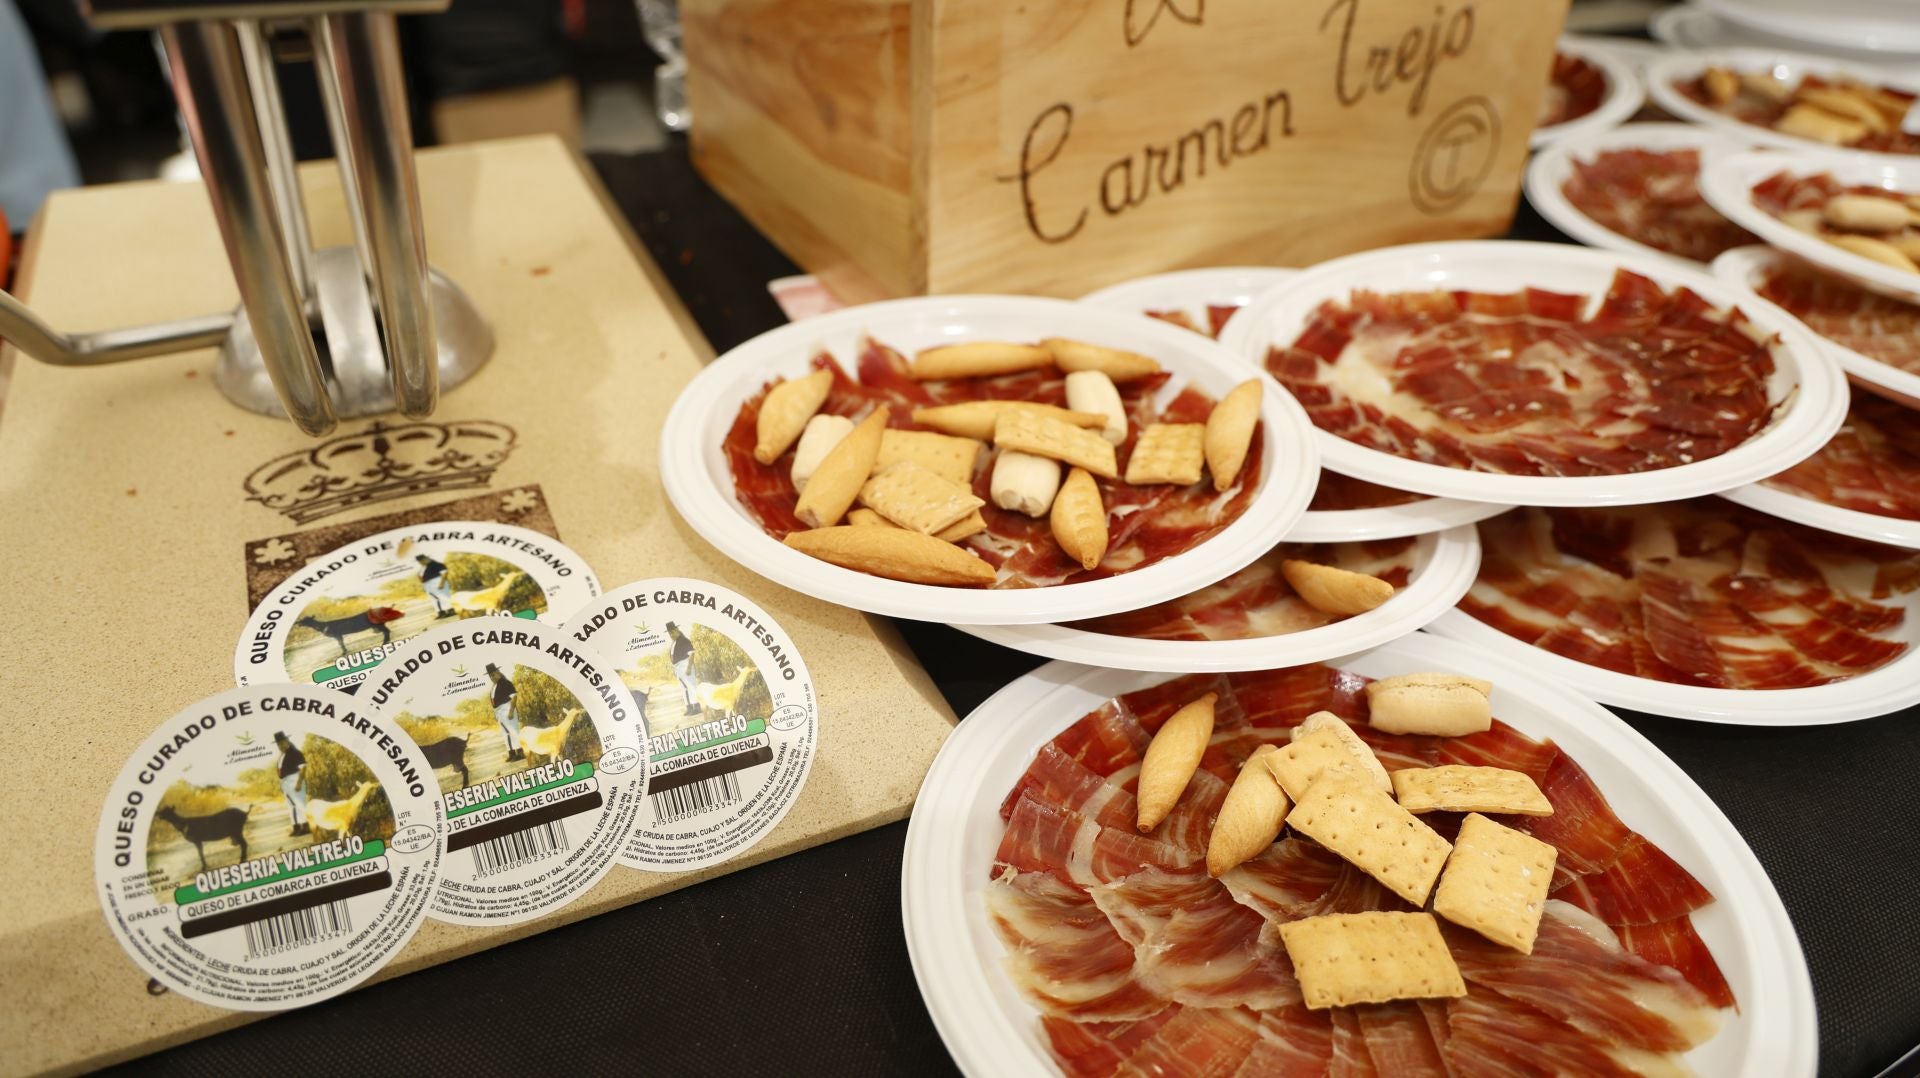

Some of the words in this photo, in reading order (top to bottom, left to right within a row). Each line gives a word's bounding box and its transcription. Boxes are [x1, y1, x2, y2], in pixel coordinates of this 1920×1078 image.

[997, 90, 1295, 244] Carmen
[250, 609, 283, 665] QUESO
[279, 553, 358, 606] CURADO
[364, 540, 395, 556] DE
[482, 533, 573, 578] ARTESANO
[573, 606, 618, 642] RADO
[621, 593, 648, 613] DE
[653, 590, 717, 611] CABRA
[720, 603, 796, 681] ARTESANO
[326, 671, 367, 689] QUESO
[370, 649, 434, 709] URADO
[437, 635, 466, 655] DE
[471, 629, 541, 650] CABRA
[545, 642, 627, 722] ARTESANO
[444, 676, 479, 690] Alimentos
[227, 744, 266, 758] Alimentos
[612, 750, 622, 758] ES
[650, 765, 661, 776] LA
[662, 750, 707, 772] COMARCA
[707, 746, 719, 761] DE
[721, 736, 762, 758] OLIVENZA
[678, 714, 747, 750] VALTREJO
[114, 790, 144, 868] QUESO
[138, 714, 217, 785] CURADO
[221, 700, 254, 721] DE
[260, 696, 336, 719] CABRA
[340, 711, 425, 798] ARTESANO
[443, 781, 500, 812] ESERIA
[499, 758, 574, 795] VALTREJO
[616, 763, 626, 771] UE
[454, 817, 467, 831] DE
[469, 813, 483, 827] LA
[483, 800, 530, 822] COMARCA
[531, 795, 544, 810] DE
[545, 781, 591, 804] OLIVENZA
[642, 830, 665, 840] CRUDA
[665, 833, 675, 841] DE
[699, 823, 720, 836] CUAJO
[737, 798, 758, 817] ORIGEN
[755, 791, 764, 801] DE
[761, 784, 770, 794] LA
[767, 764, 780, 786] LECHE
[407, 828, 417, 836] ES
[410, 842, 419, 850] UE
[462, 884, 486, 894] CRUDA
[487, 886, 497, 894] DE
[523, 874, 546, 888] CUAJO
[564, 847, 586, 867] ORIGEN
[583, 838, 593, 849] DE
[590, 830, 600, 840] LA
[595, 810, 611, 832] LECHE
[187, 899, 225, 918] QUESO
[227, 895, 243, 911] DE
[244, 891, 259, 906] LA
[260, 878, 313, 900] COMARCA
[314, 874, 328, 890] DE
[330, 860, 380, 883] OLIVENZA
[195, 855, 280, 894] QUESERIA
[281, 835, 364, 873] VALTREJO
[567, 886, 577, 894] DE
[207, 957, 231, 973] LECHE
[232, 964, 257, 976] CRUDA
[259, 968, 270, 976] DE
[300, 957, 325, 970] CUAJO
[346, 927, 371, 950] ORIGEN
[368, 920, 380, 931] DE
[376, 913, 387, 922] LA
[383, 891, 400, 914] LECHE
[348, 971, 358, 979] DE
